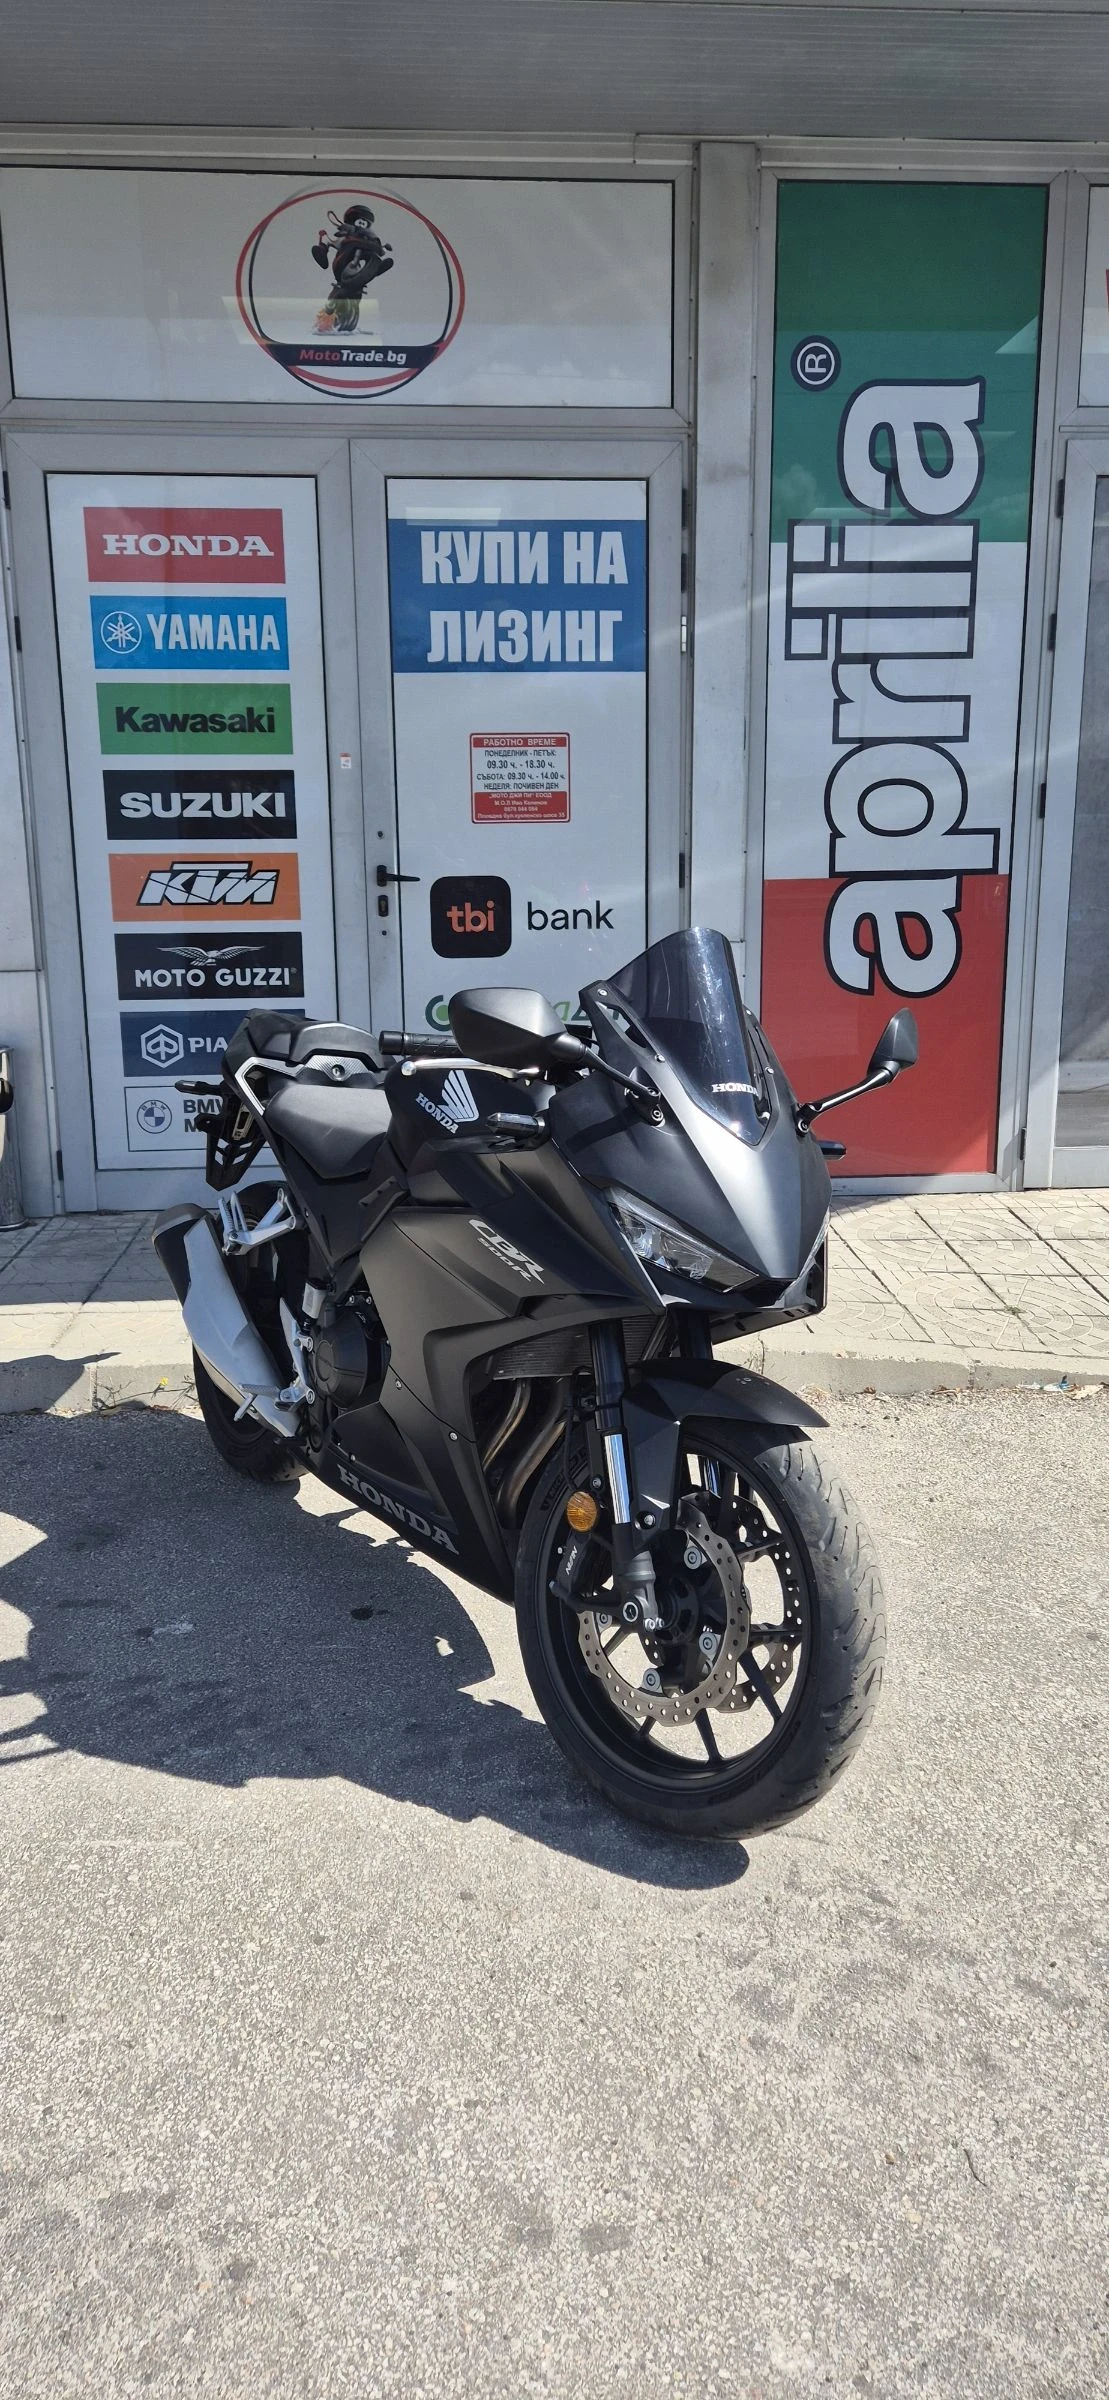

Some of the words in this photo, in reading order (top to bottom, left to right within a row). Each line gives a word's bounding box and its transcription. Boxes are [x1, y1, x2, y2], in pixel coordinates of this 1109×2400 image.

[102, 534, 275, 557] HONDA
[421, 531, 549, 584] КУПИ
[563, 531, 629, 584] НА
[146, 613, 281, 651] YAMAHA
[427, 609, 623, 663] ЛИЗИНГ
[785, 375, 1000, 998] aprilia
[115, 706, 276, 733] Kawasaki
[483, 738, 523, 746] РАБОТНО
[527, 738, 557, 746] ВРЕМЕ
[476, 773, 506, 781] СЪБОТА:
[507, 772, 526, 780] 09.30
[540, 772, 559, 780] 14.00
[486, 760, 508, 769] 09.30
[525, 759, 546, 768] 18.30
[513, 782, 545, 790] ПОЧИВЕН
[545, 782, 559, 790] ДЕН
[120, 792, 287, 819] SUZUKI
[136, 861, 281, 906] KTM
[446, 900, 495, 933] tbi
[527, 900, 615, 931] bank
[134, 968, 206, 988] MOTO
[215, 967, 290, 987] GUZZI
[711, 1082, 759, 1097] HONDA
[415, 1092, 459, 1134] HONDA
[468, 1218, 545, 1285] CBR
[337, 1463, 460, 1556] HONDA
